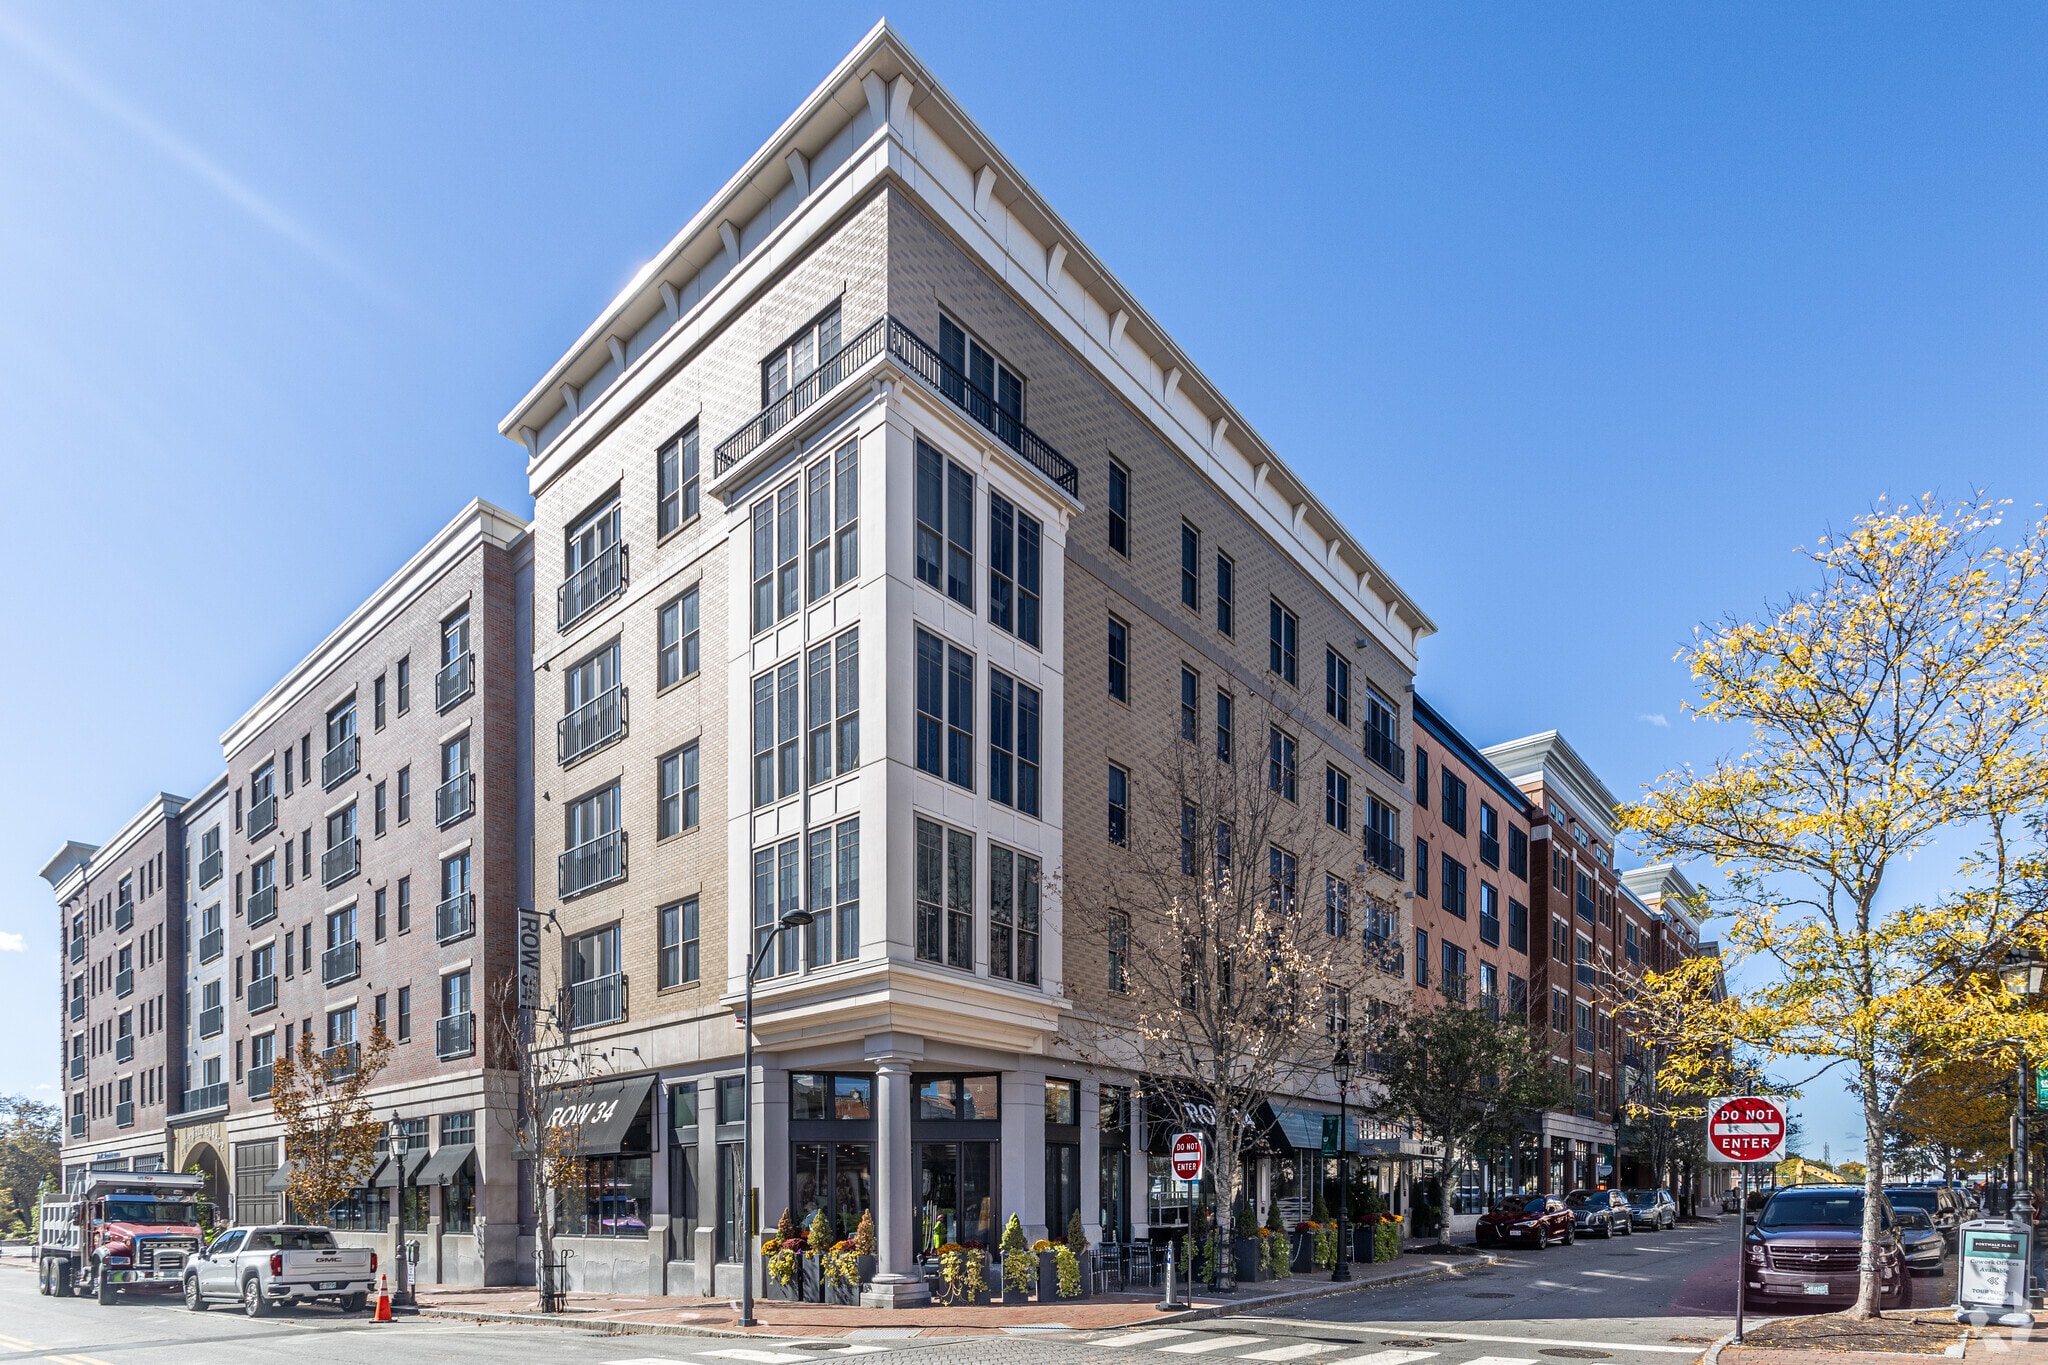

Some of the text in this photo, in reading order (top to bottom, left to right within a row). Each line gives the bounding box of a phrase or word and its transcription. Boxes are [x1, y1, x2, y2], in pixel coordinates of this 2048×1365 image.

[521, 917, 539, 970] ROW
[545, 1099, 619, 1129] ROW 34
[1183, 1102, 1222, 1126] RO
[1721, 1109, 1774, 1121] DO NOT
[1176, 1142, 1198, 1151] DO NOT
[1722, 1138, 1770, 1149] ENTER
[1177, 1163, 1197, 1171] ENTER
